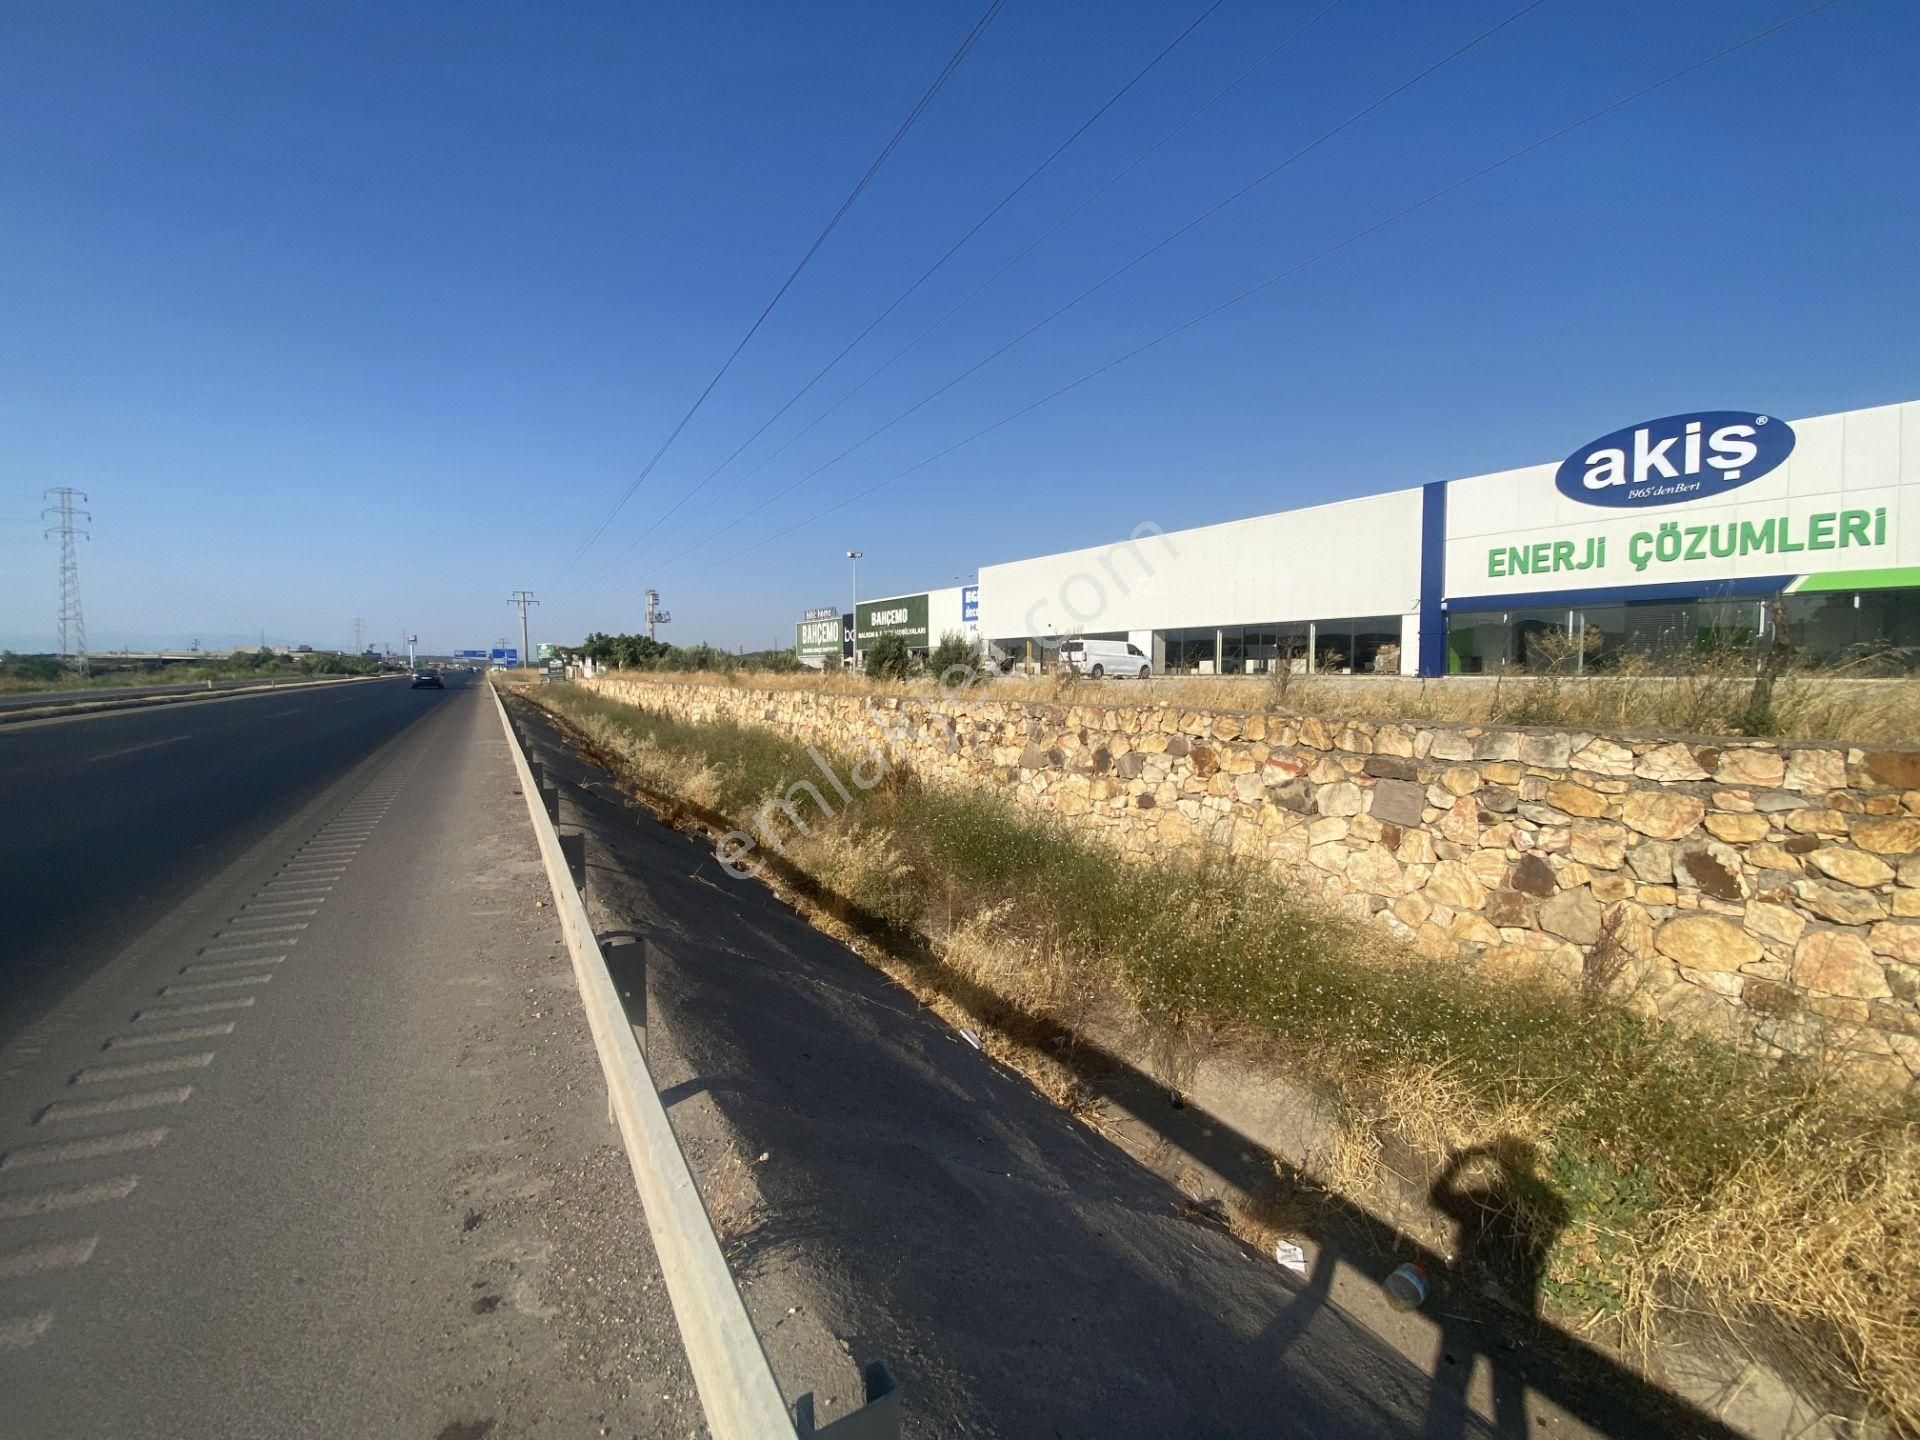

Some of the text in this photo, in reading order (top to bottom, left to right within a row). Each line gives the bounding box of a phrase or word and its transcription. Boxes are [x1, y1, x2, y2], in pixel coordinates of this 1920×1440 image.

[1583, 421, 1758, 490] akiş
[870, 608, 908, 627] BAHÇEMO
[802, 622, 839, 645] BAHÇEMO
